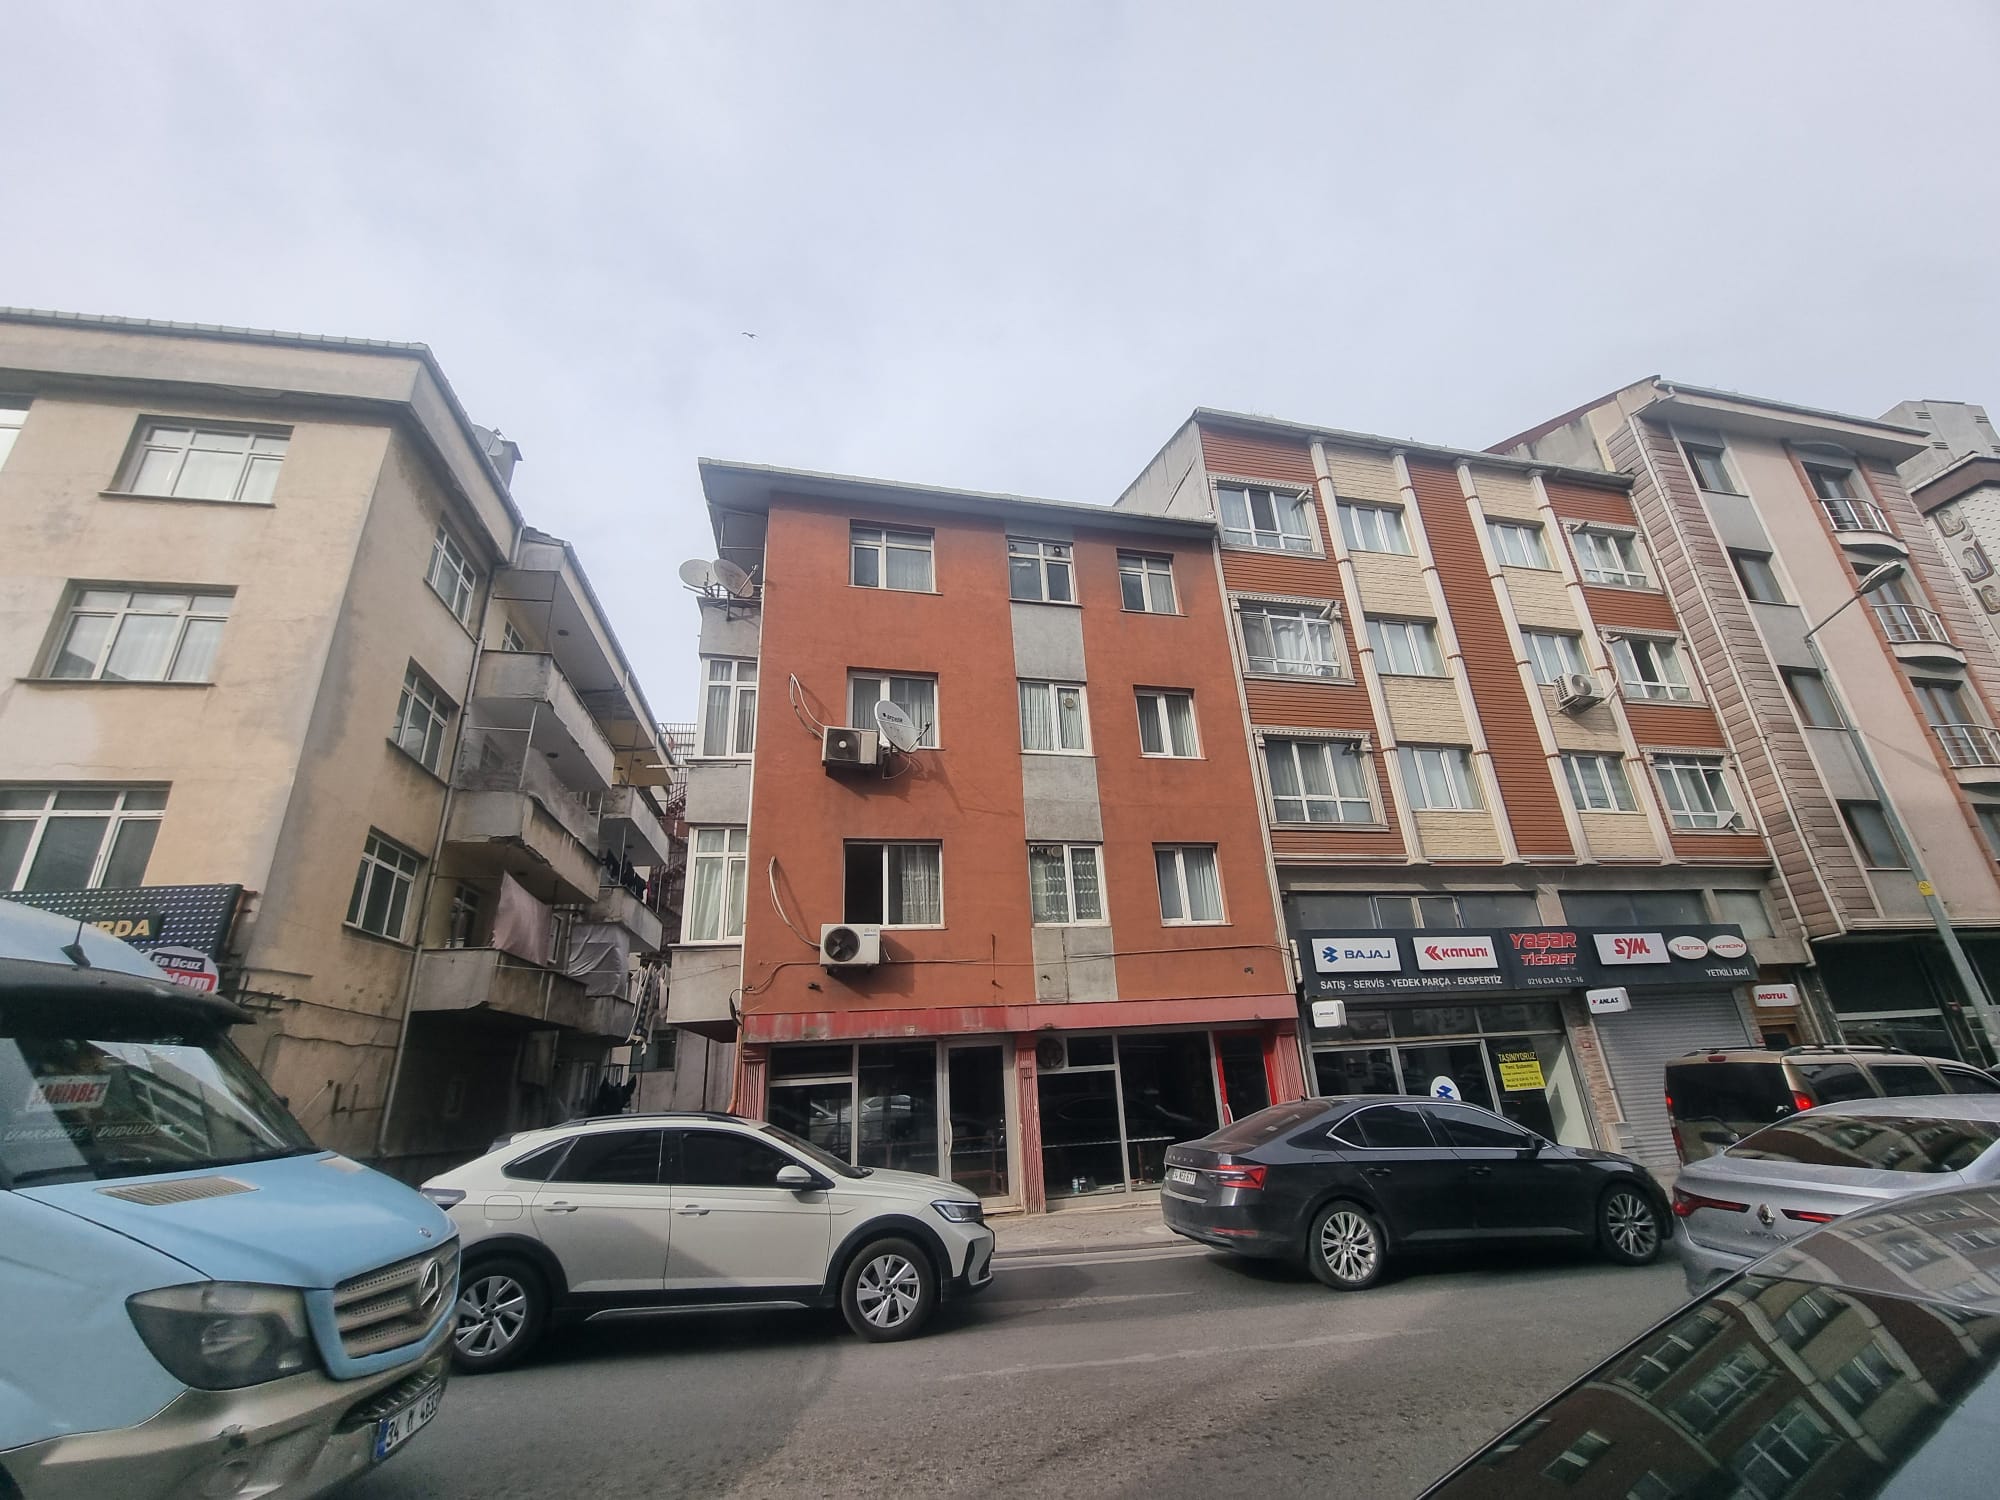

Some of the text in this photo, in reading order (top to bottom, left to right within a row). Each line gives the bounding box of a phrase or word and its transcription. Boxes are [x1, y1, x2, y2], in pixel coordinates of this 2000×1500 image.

[93, 919, 150, 937] RDA
[1344, 949, 1391, 959] BAJAJ
[1614, 937, 1651, 960] SYM
[170, 957, 203, 970] Ucuz
[1705, 966, 1750, 977] YETKİLİ BAYİ
[1320, 980, 1346, 991] SATIŞ
[1353, 978, 1385, 989] SERVİS
[1391, 977, 1421, 988] YEDEK
[1422, 977, 1452, 988] PARÇA
[1457, 974, 1503, 985] EKSPERTİZ
[1758, 992, 1788, 1000] MOTUL
[386, 1420, 399, 1448] 34
